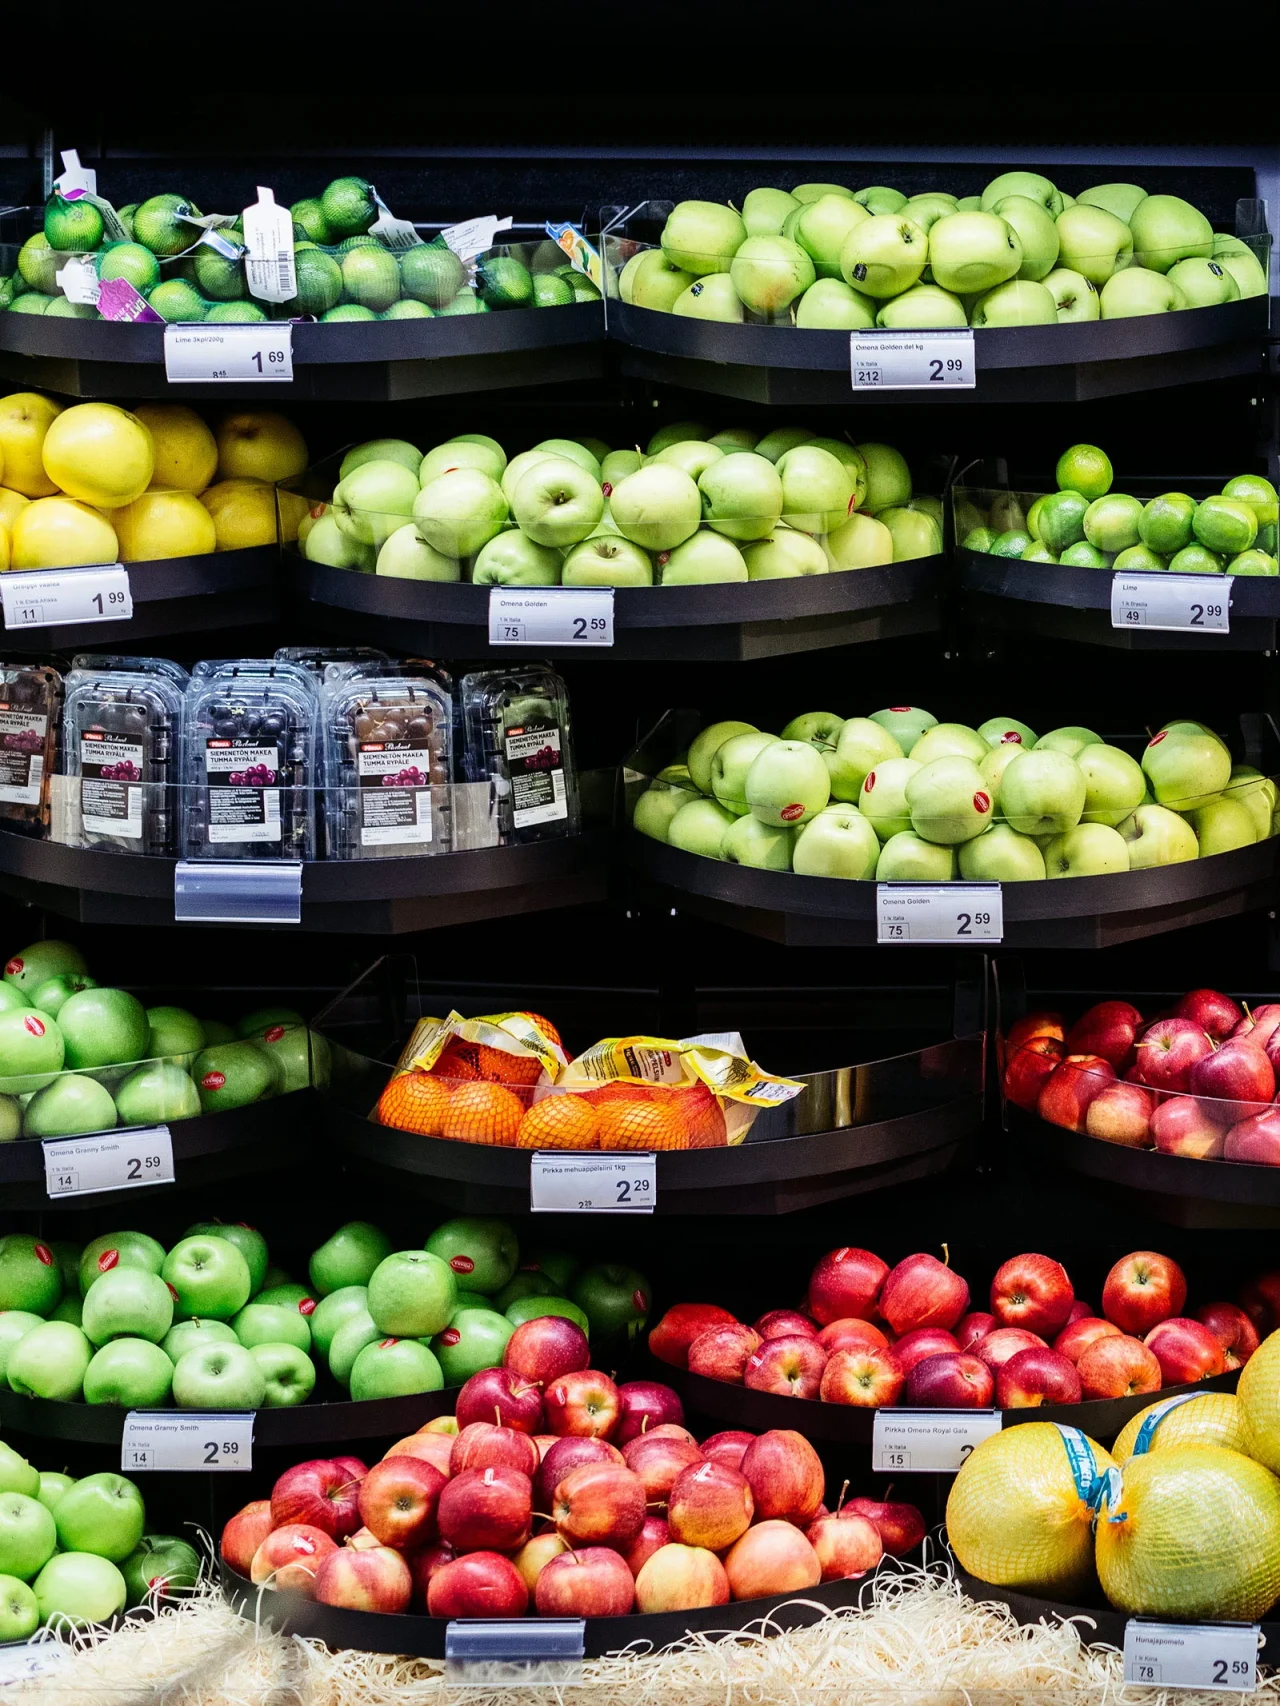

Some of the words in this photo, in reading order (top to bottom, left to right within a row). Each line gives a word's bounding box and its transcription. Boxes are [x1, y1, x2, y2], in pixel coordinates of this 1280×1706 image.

[916, 344, 924, 352] kg
[252, 351, 263, 373] 1
[269, 351, 284, 362] 69
[859, 372, 879, 381] 212
[930, 360, 944, 381] 2
[947, 360, 962, 371] 99
[92, 593, 103, 615] 1
[109, 592, 124, 603] 99
[22, 609, 35, 619] 11
[1127, 611, 1139, 620] 49
[1190, 604, 1204, 625] 2
[1207, 605, 1221, 616] 99
[505, 627, 518, 637] 75
[573, 618, 587, 639] 2
[591, 619, 606, 629] 59
[957, 913, 972, 935] 2
[975, 913, 990, 924] 59
[889, 926, 902, 935] 75
[50, 1149, 74, 1157] Omena
[75, 1147, 99, 1155] Granny
[100, 1144, 120, 1152] Smith
[127, 1158, 142, 1180] 2
[145, 1156, 160, 1168] 59
[564, 1165, 612, 1174] mehuappelsiini
[615, 1164, 626, 1172] 1kg
[58, 1176, 72, 1186] 14
[616, 1180, 631, 1202] 2
[634, 1180, 650, 1191] 29
[133, 1453, 146, 1462] 14
[204, 1442, 218, 1464] 2
[223, 1442, 238, 1453] 59
[890, 1455, 903, 1464] 15
[1136, 1636, 1184, 1646] Hunajapomelo
[1139, 1666, 1153, 1678] 78
[1213, 1659, 1228, 1683] 2
[1232, 1661, 1248, 1673] 59
